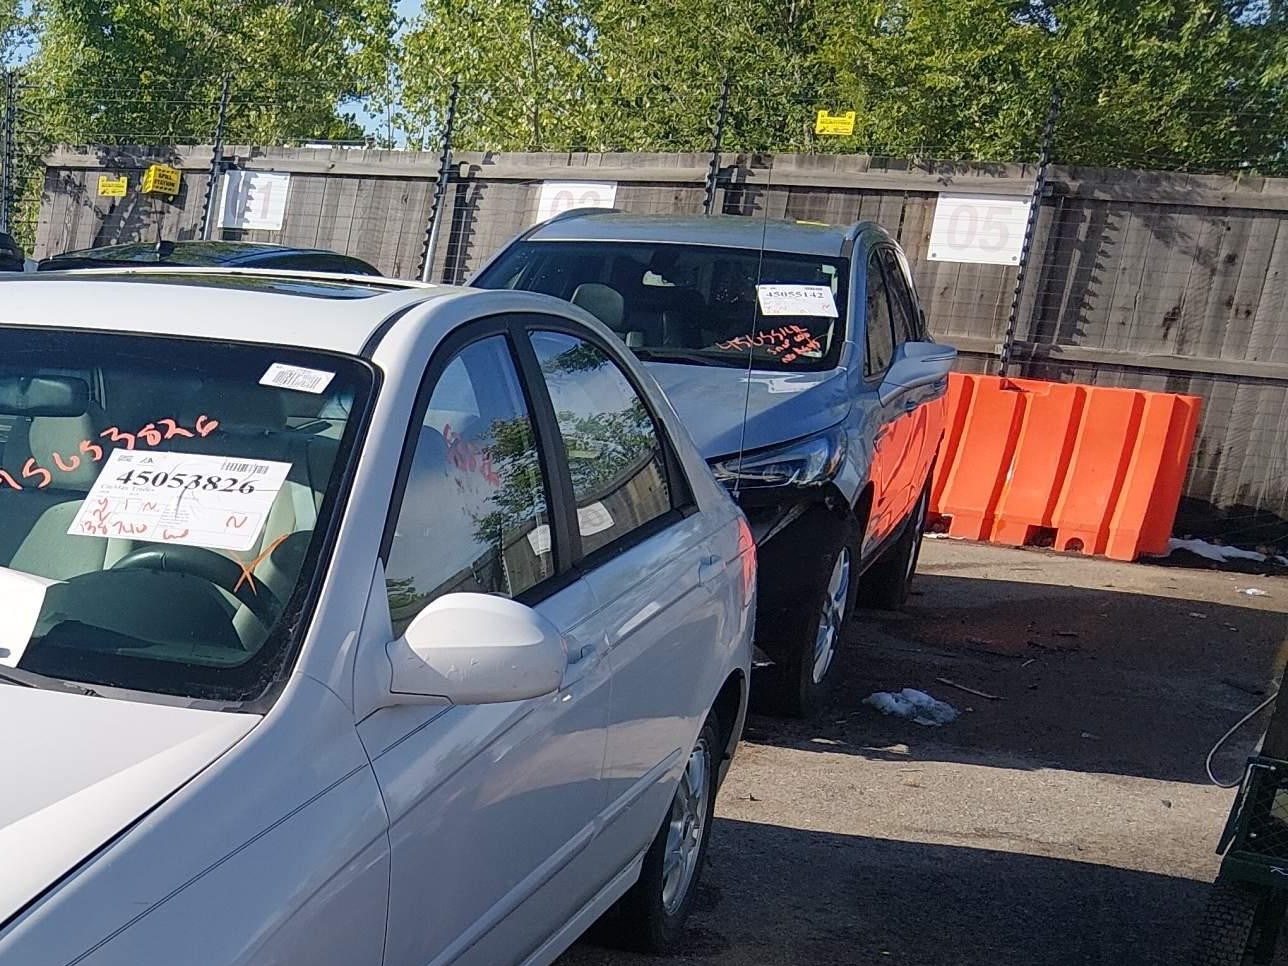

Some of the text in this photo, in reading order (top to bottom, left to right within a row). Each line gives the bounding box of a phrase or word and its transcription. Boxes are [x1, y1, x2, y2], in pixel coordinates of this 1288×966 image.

[155, 179, 175, 187] STATION
[947, 204, 1012, 253] 05
[117, 469, 256, 495] 45053826
